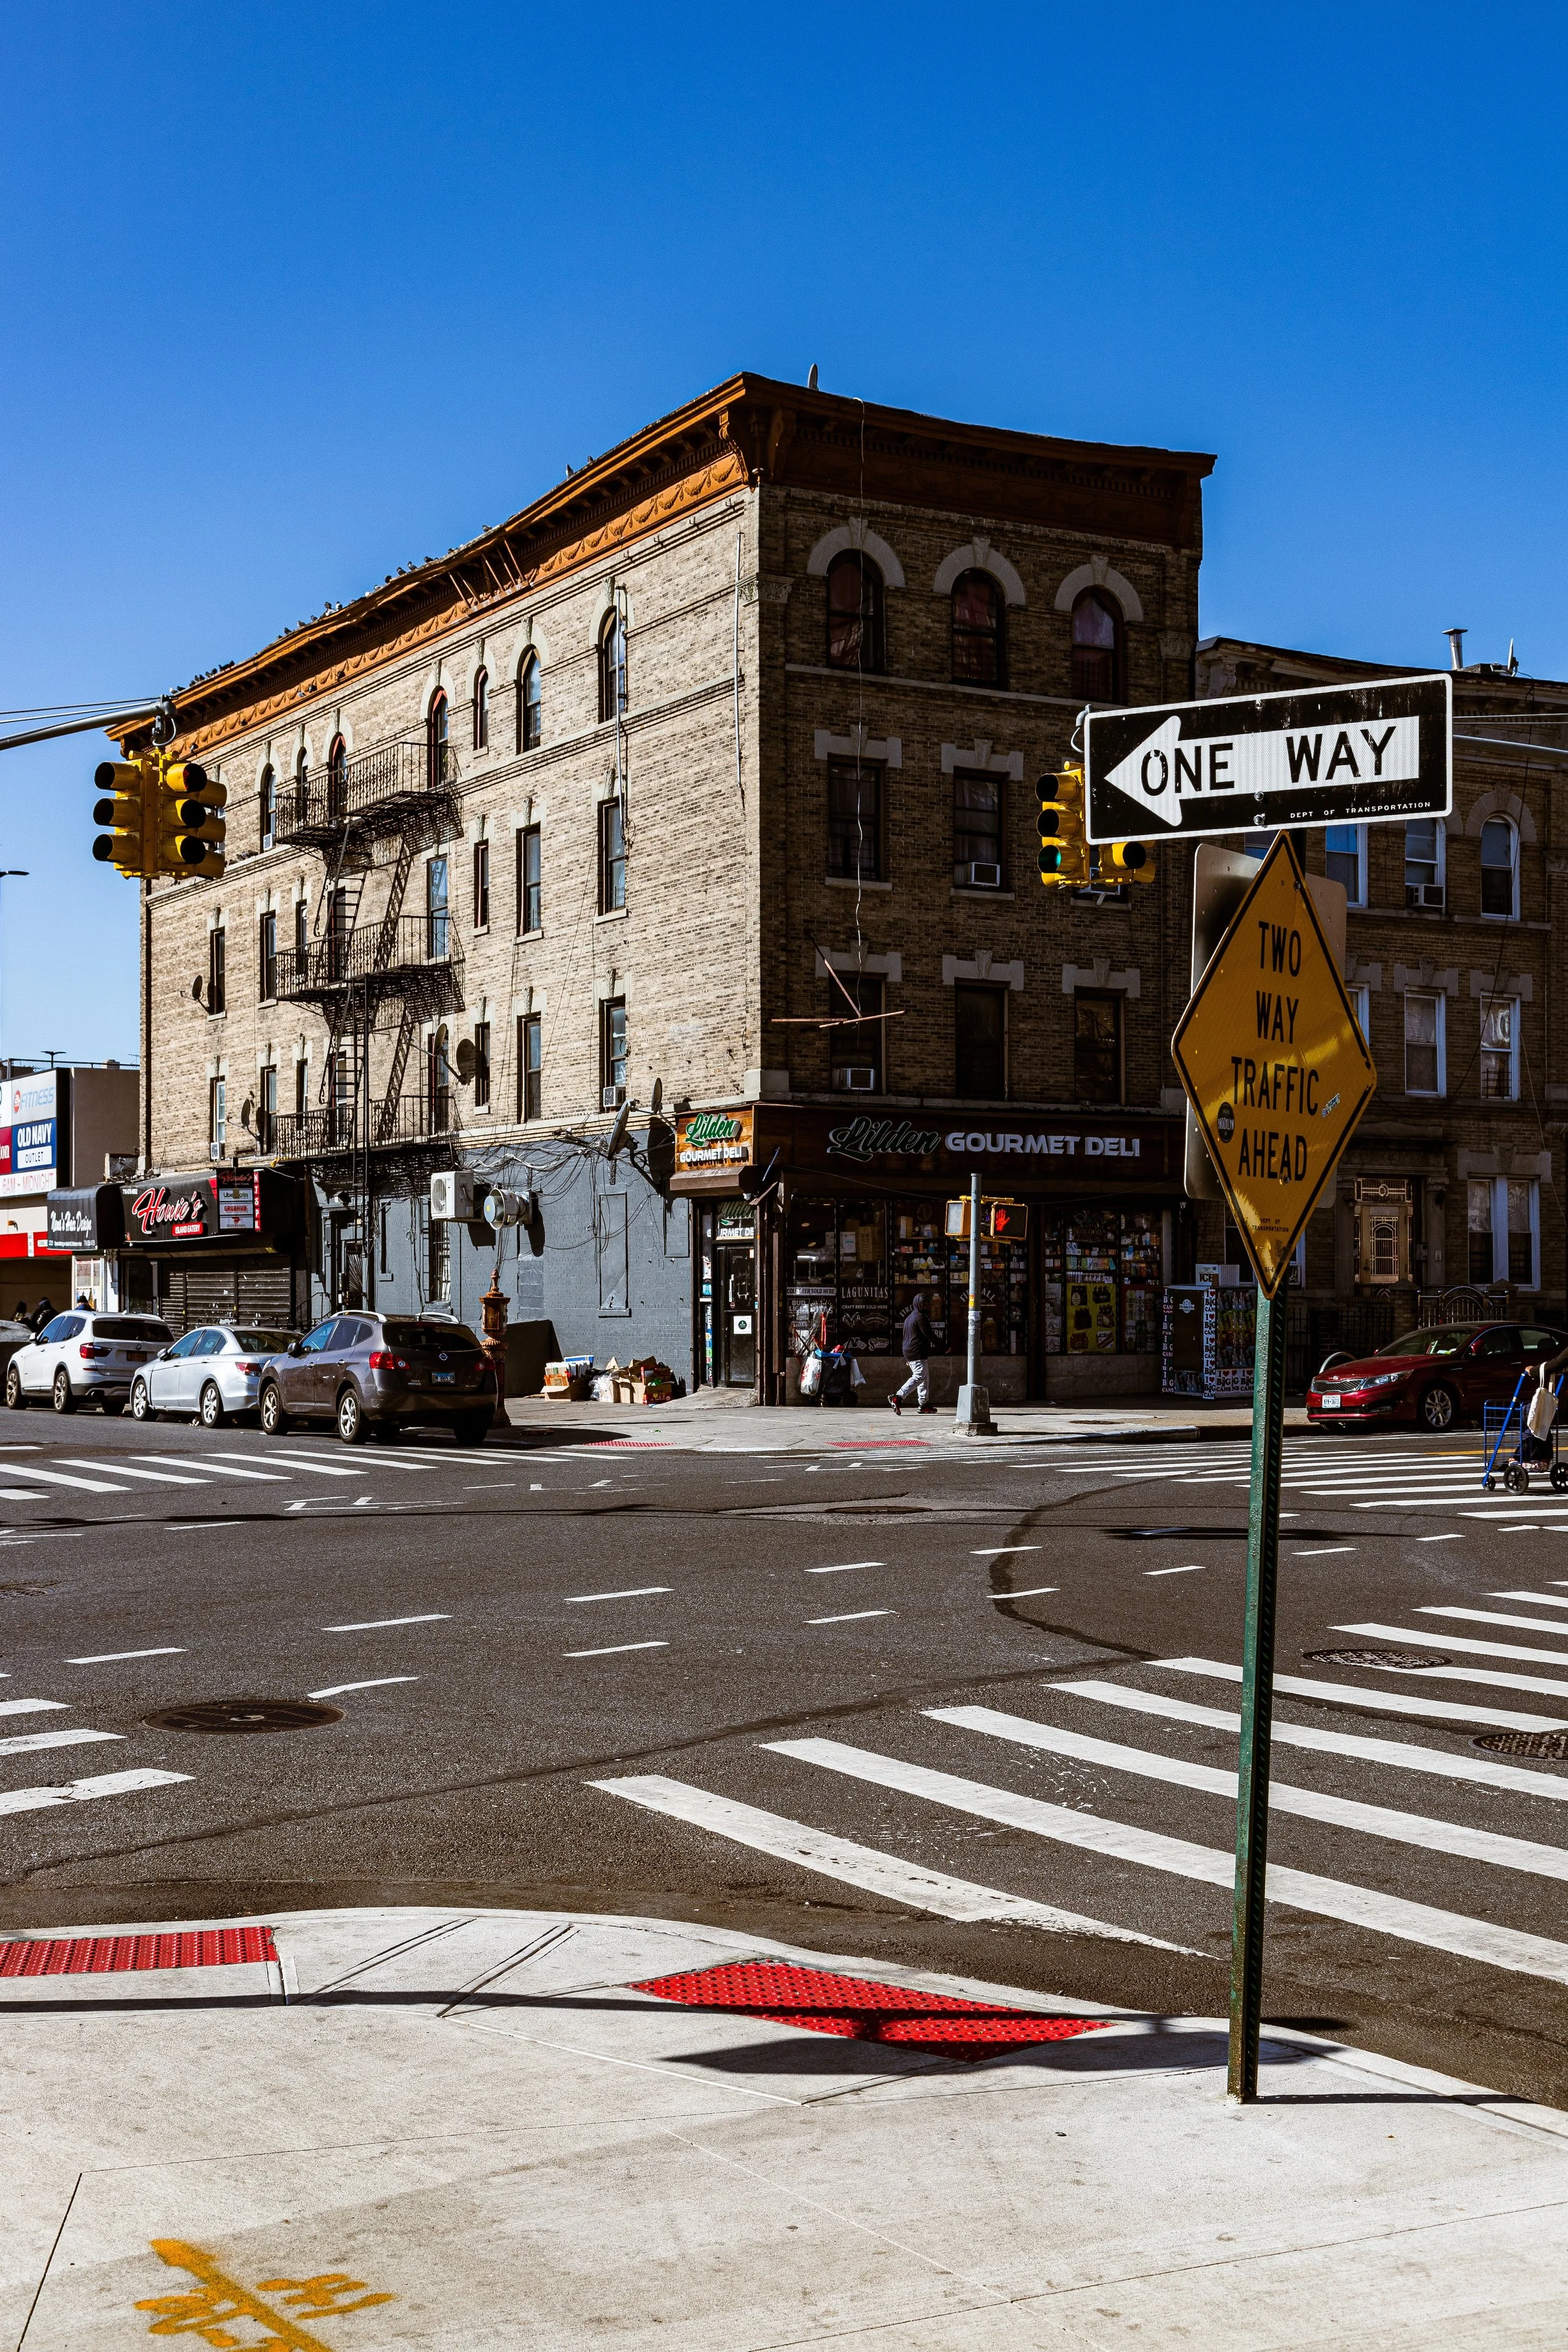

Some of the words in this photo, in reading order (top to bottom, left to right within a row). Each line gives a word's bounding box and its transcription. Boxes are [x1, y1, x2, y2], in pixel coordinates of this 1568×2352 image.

[1141, 742, 1234, 797] ONE
[1286, 726, 1396, 784] WAY
[1345, 802, 1431, 814] TRANSPORTATION
[1258, 920, 1302, 978] TWO
[1256, 990, 1299, 1044] WAY
[20, 1087, 55, 1110] FITNESS
[1231, 1056, 1319, 1116] TRAFFIC
[18, 1126, 32, 1148] OLD
[32, 1123, 52, 1145] NAVY
[685, 1113, 739, 1148] Lilden
[827, 1116, 941, 1162] Lilden
[944, 1131, 1081, 1154] GOURMET
[1084, 1136, 1140, 1157] DELI
[26, 1152, 43, 1163] OUTLET
[680, 1148, 722, 1163] GOURMET
[723, 1147, 744, 1158] DELI
[1238, 1128, 1308, 1182] AHEAD
[3, 1177, 16, 1195] 6AM
[23, 1173, 54, 1192] MIDNIGHT
[132, 1187, 203, 1234] Howie's
[175, 1225, 187, 1234] ISLAND
[188, 1224, 200, 1233] EATERY
[842, 1287, 888, 1298] LAGUNITAS
